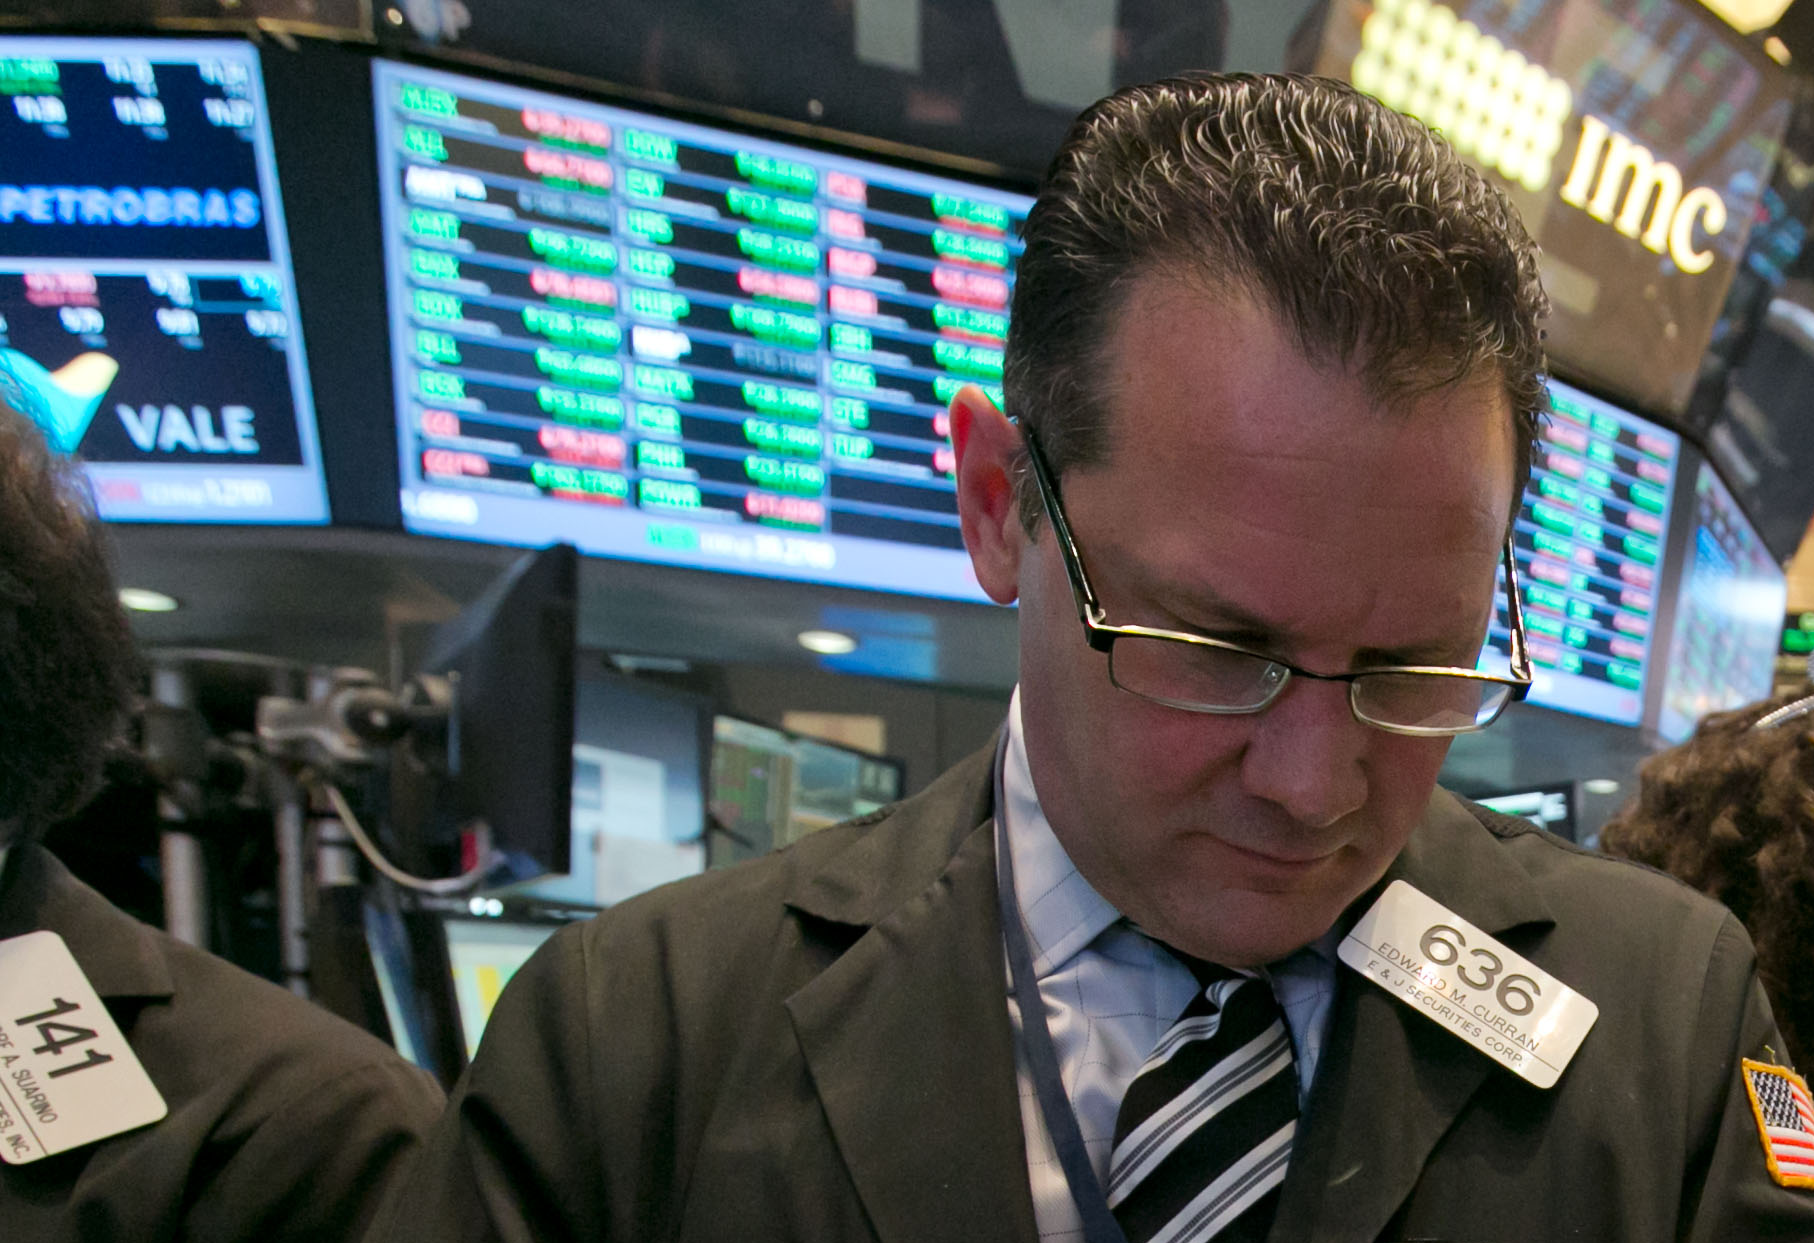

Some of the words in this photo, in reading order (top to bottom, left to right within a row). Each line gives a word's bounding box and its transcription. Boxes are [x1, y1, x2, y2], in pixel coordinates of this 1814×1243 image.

[0, 184, 261, 228] PETROBRAS
[115, 404, 260, 454] VALE
[1367, 960, 1379, 970] E
[1380, 968, 1391, 980] &
[1393, 977, 1404, 987] J
[1405, 984, 1483, 1038] SECURITIES
[1484, 1036, 1523, 1067] CORP.
[1377, 942, 1448, 991] EDWARD
[1449, 988, 1467, 1008] M.
[1473, 1004, 1540, 1052] CURRAN
[1419, 924, 1542, 1017] 636
[14, 997, 114, 1079] 141
